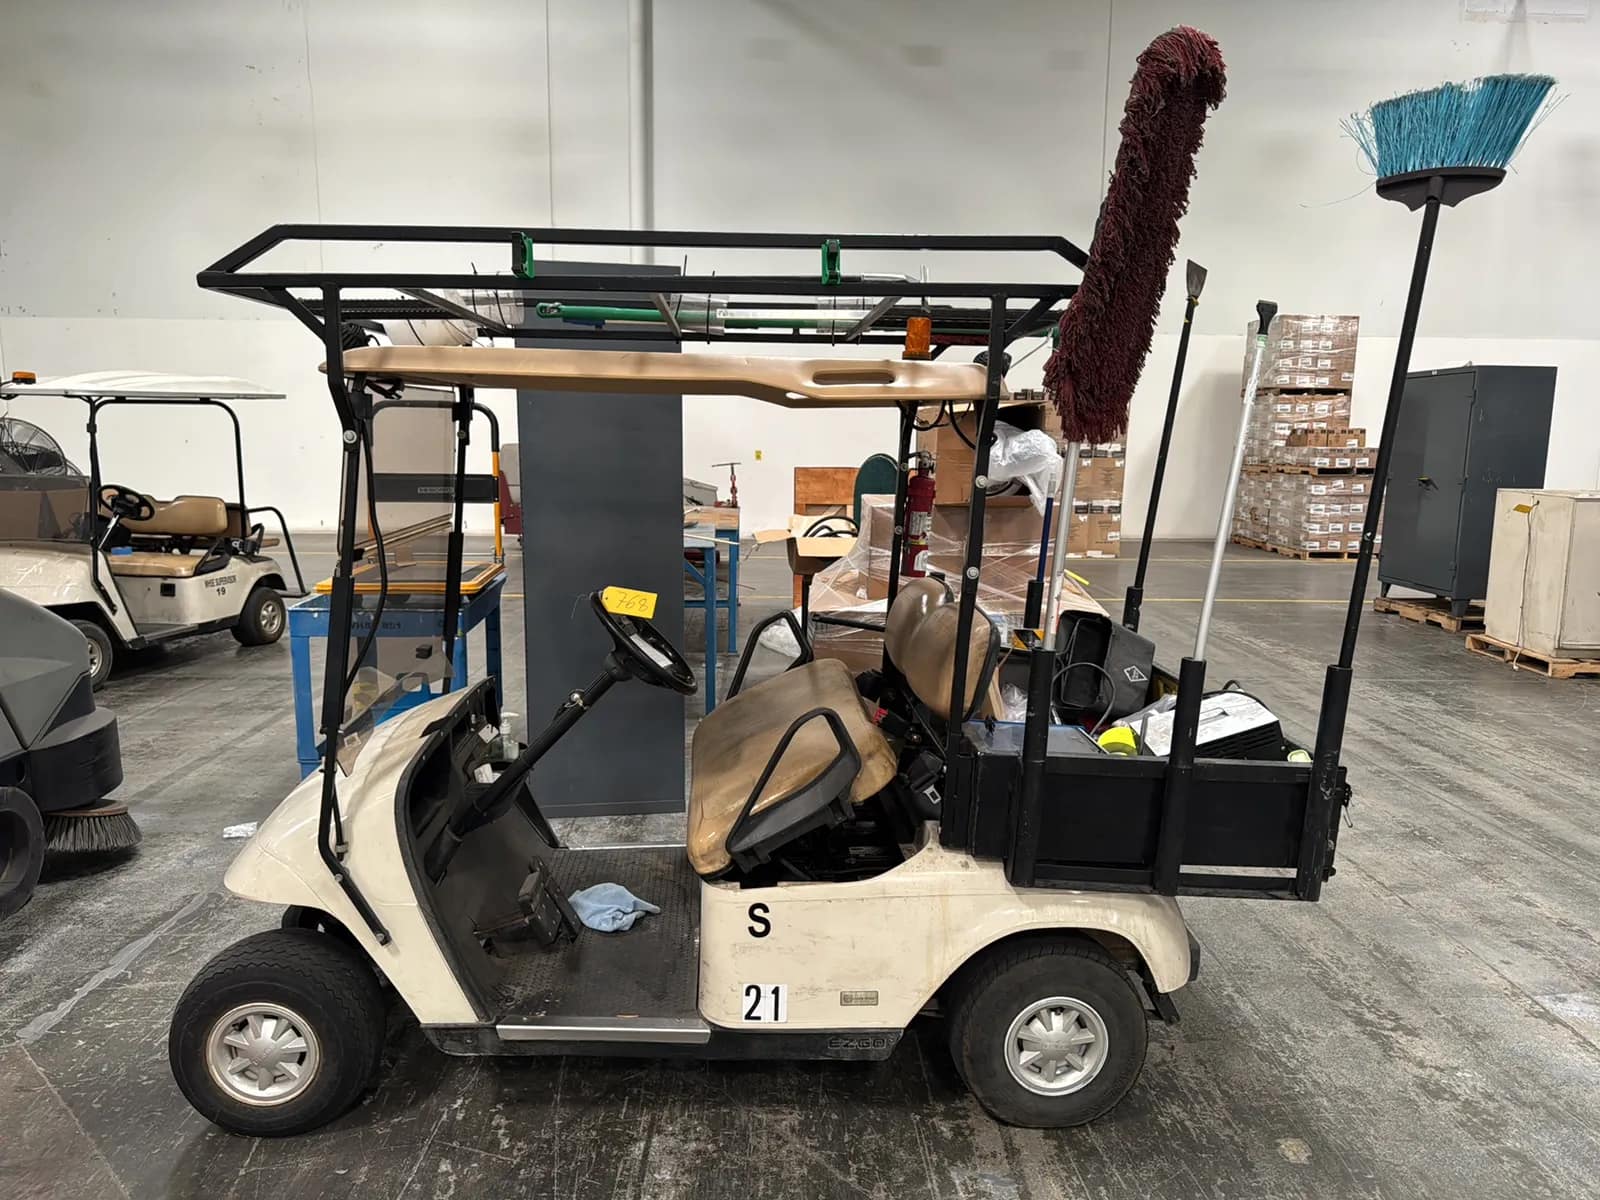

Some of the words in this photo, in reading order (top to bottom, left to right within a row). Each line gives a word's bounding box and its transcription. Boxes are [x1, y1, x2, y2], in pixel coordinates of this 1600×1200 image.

[216, 587, 226, 596] 19
[748, 902, 772, 938] S
[744, 985, 781, 1022] 21
